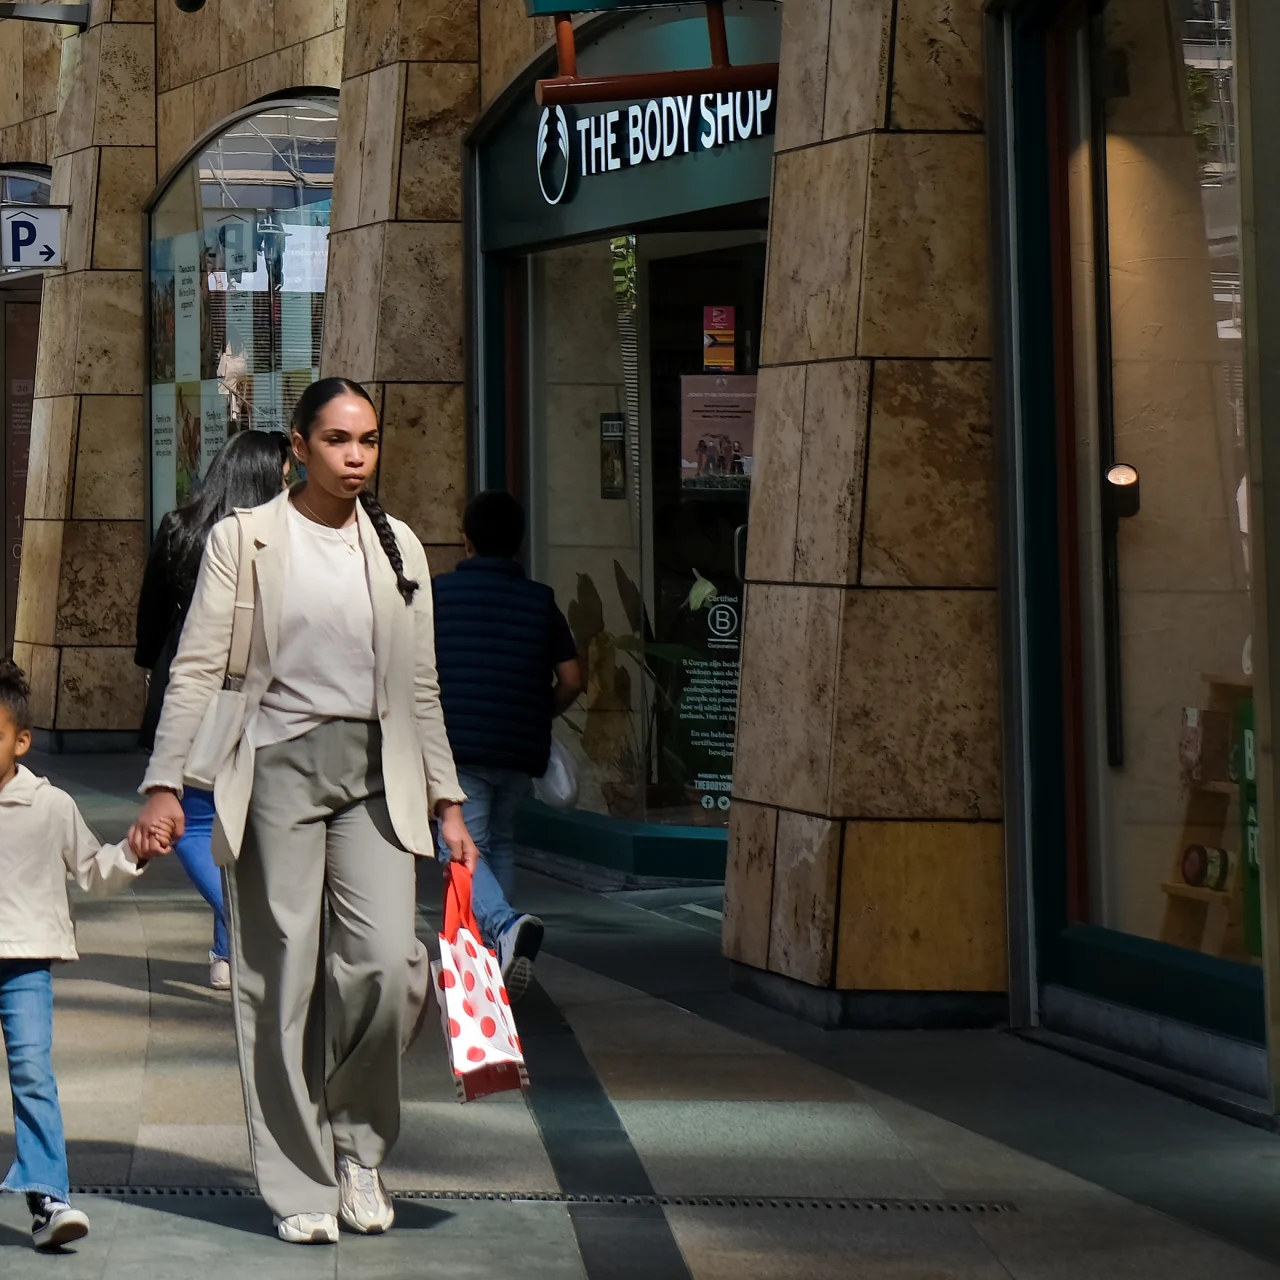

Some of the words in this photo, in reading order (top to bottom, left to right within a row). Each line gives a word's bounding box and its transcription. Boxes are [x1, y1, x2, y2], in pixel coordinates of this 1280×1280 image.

[576, 109, 621, 176] THE
[628, 94, 693, 166] BODY
[699, 88, 773, 149] SHOP
[11, 220, 37, 262] P
[716, 610, 730, 629] B
